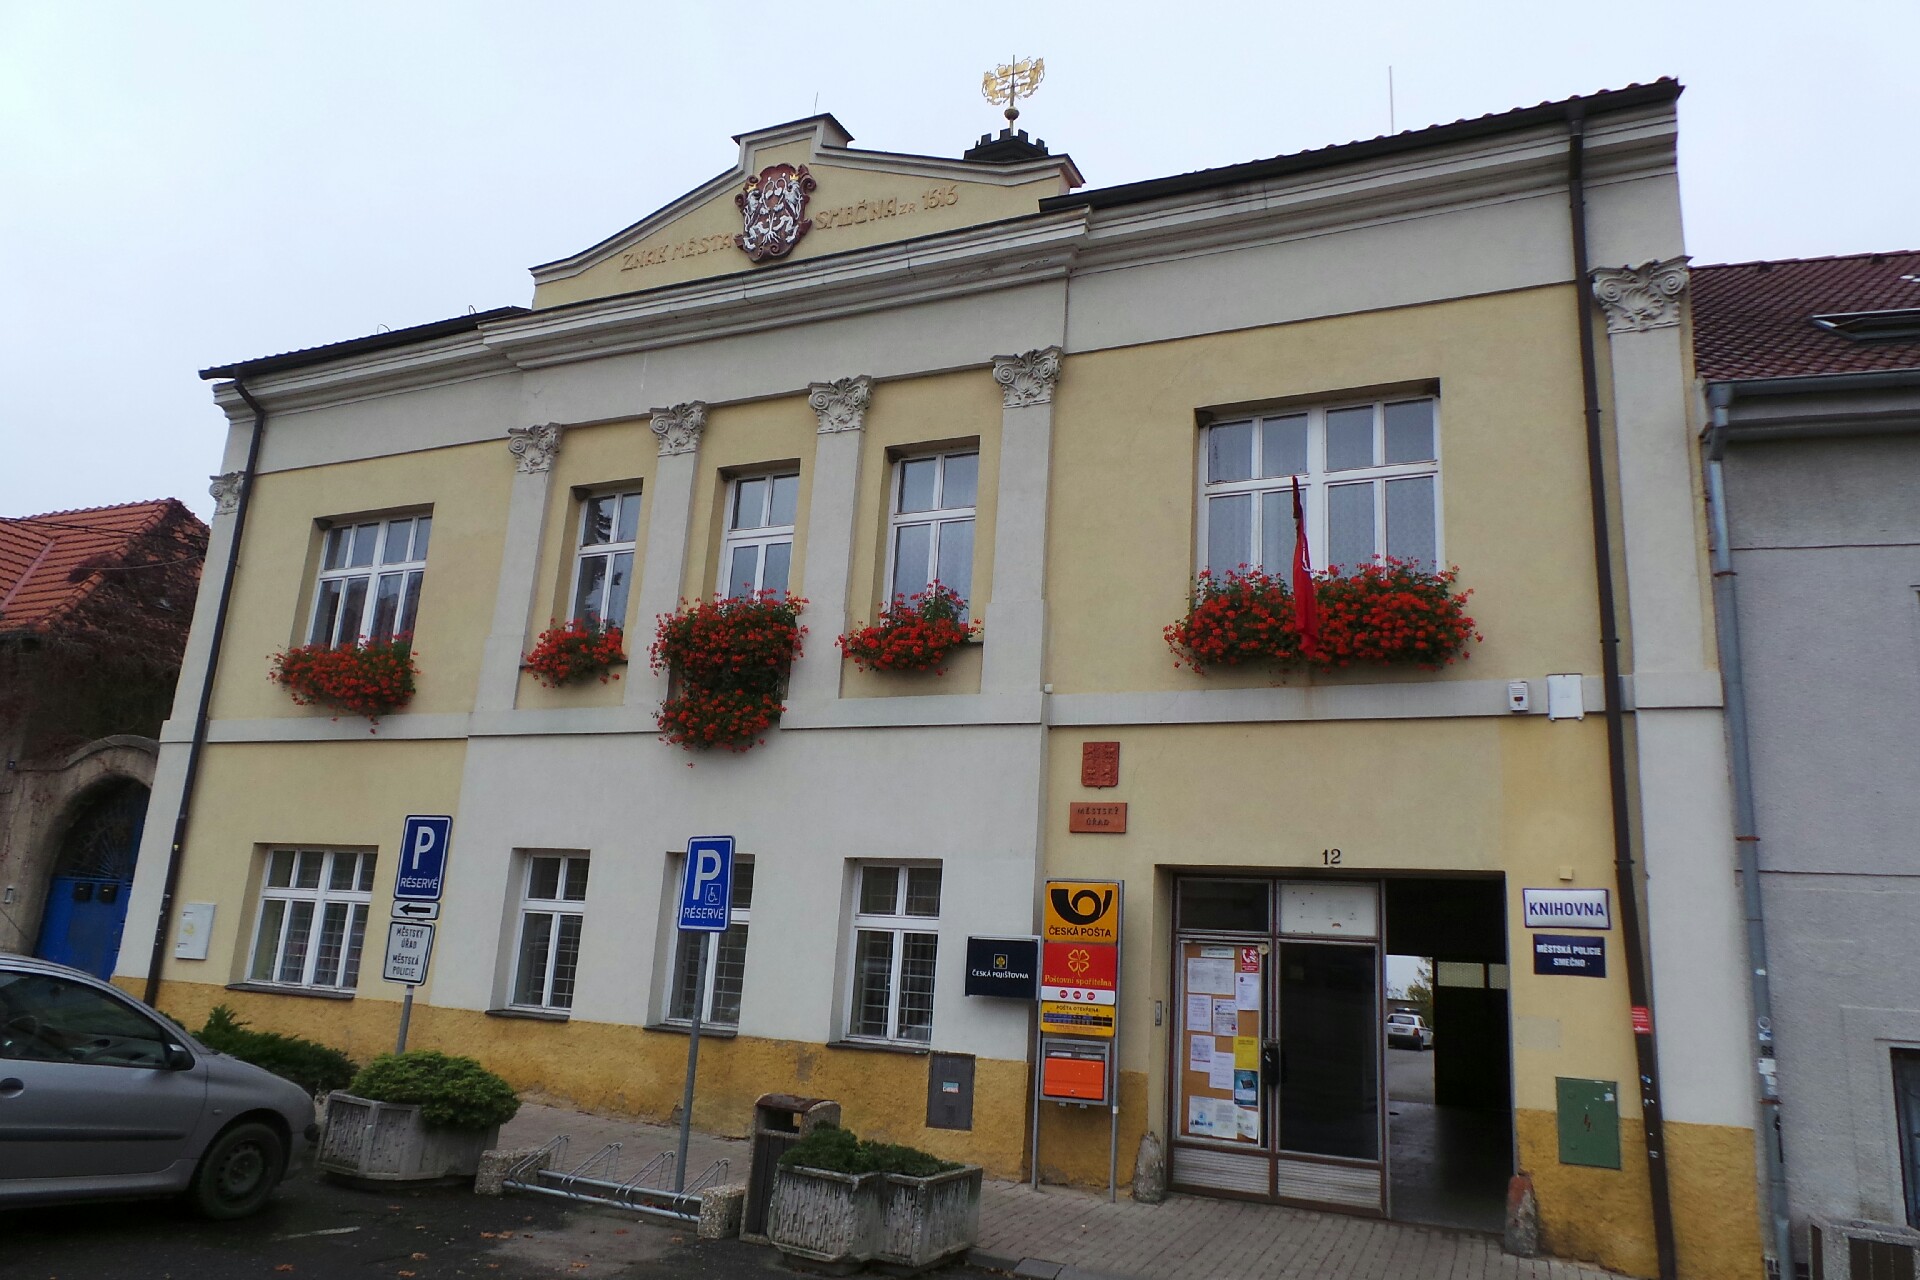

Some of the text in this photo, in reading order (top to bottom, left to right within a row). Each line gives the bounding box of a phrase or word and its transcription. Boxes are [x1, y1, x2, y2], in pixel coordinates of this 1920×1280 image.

[412, 826, 435, 870] P
[1322, 848, 1341, 865] 12
[692, 849, 722, 900] P
[400, 876, 438, 889] RÉSERVÉ
[683, 905, 725, 920] RÉSERVÉ
[1529, 902, 1604, 916] KNIHOVNA
[396, 927, 424, 939] MĚSTSKÝ
[1048, 924, 1112, 938] ČESKÁ POŠTA
[401, 938, 418, 950] ÚŘAD
[1536, 943, 1602, 956] MĚSTSKÁ POLICIE
[392, 953, 419, 966] MĚSTSKÁ
[392, 965, 416, 977] POLICIE
[971, 969, 1029, 979] ČESKÁ POJIŠŤOVNA
[1044, 974, 1112, 987] Poštovní spořitelna
